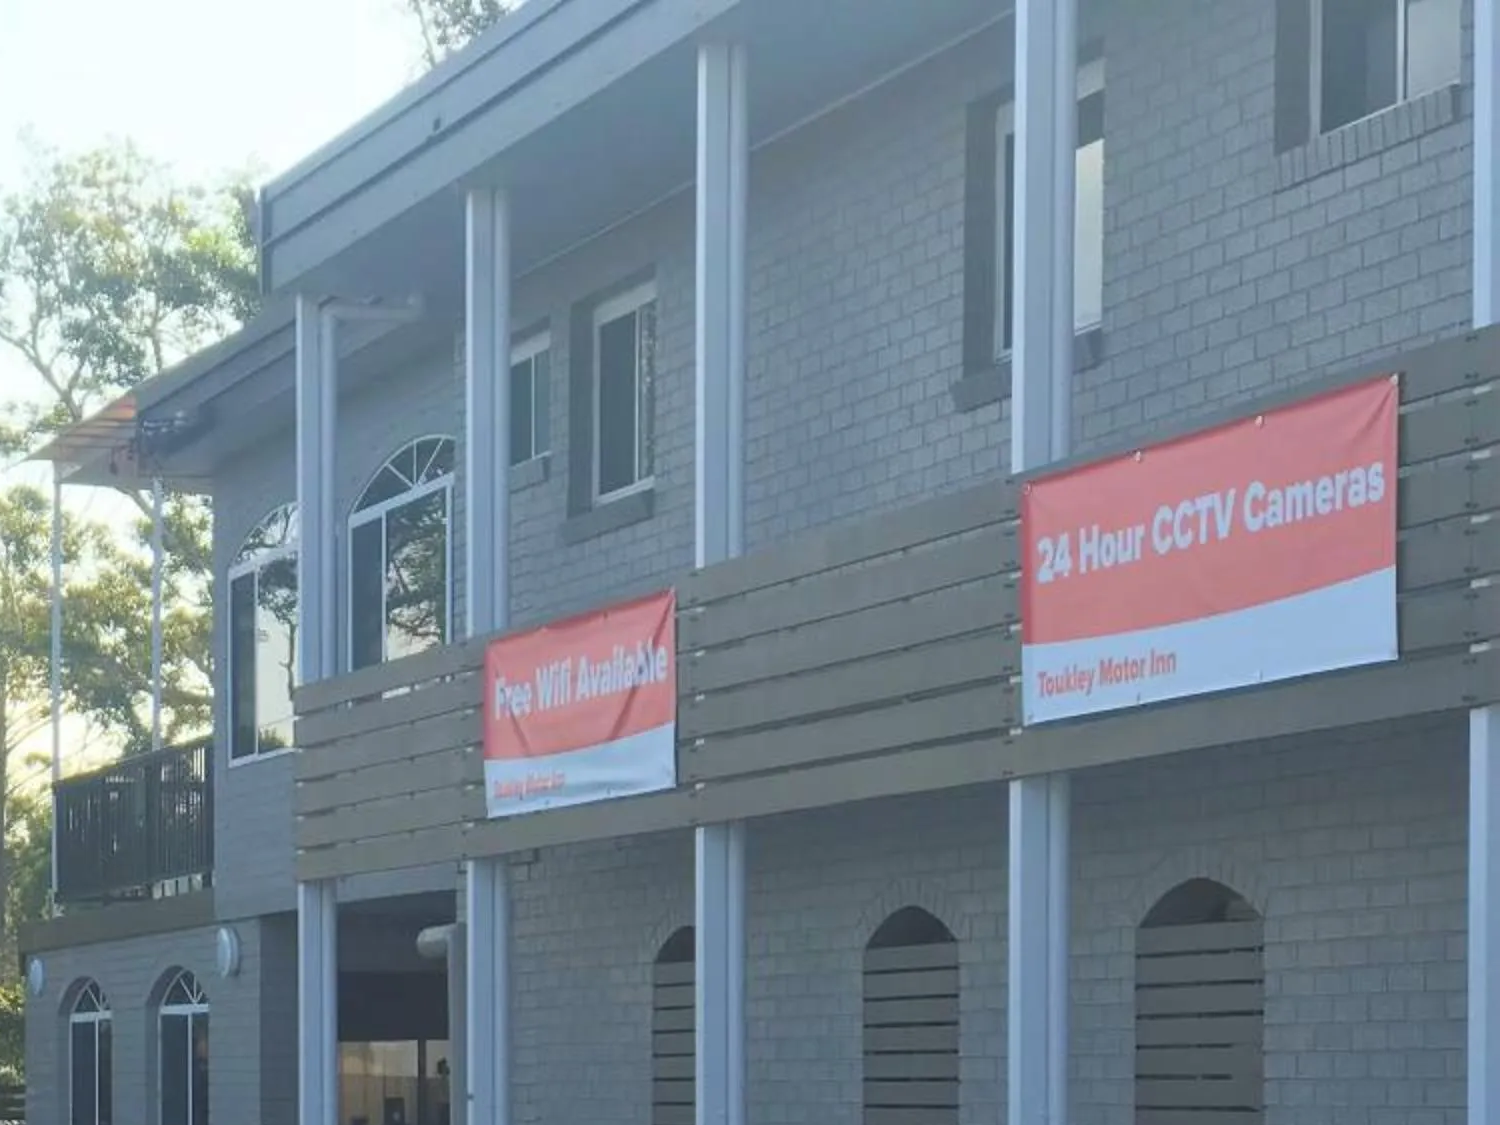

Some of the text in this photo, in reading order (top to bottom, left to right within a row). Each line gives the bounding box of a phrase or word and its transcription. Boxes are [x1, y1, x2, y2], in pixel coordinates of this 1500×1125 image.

[1036, 461, 1385, 584] 24 Hour CCTV Cameras
[494, 675, 532, 722] Free
[575, 635, 668, 702] Available
[1037, 647, 1177, 699] Toukley Motor Inn
